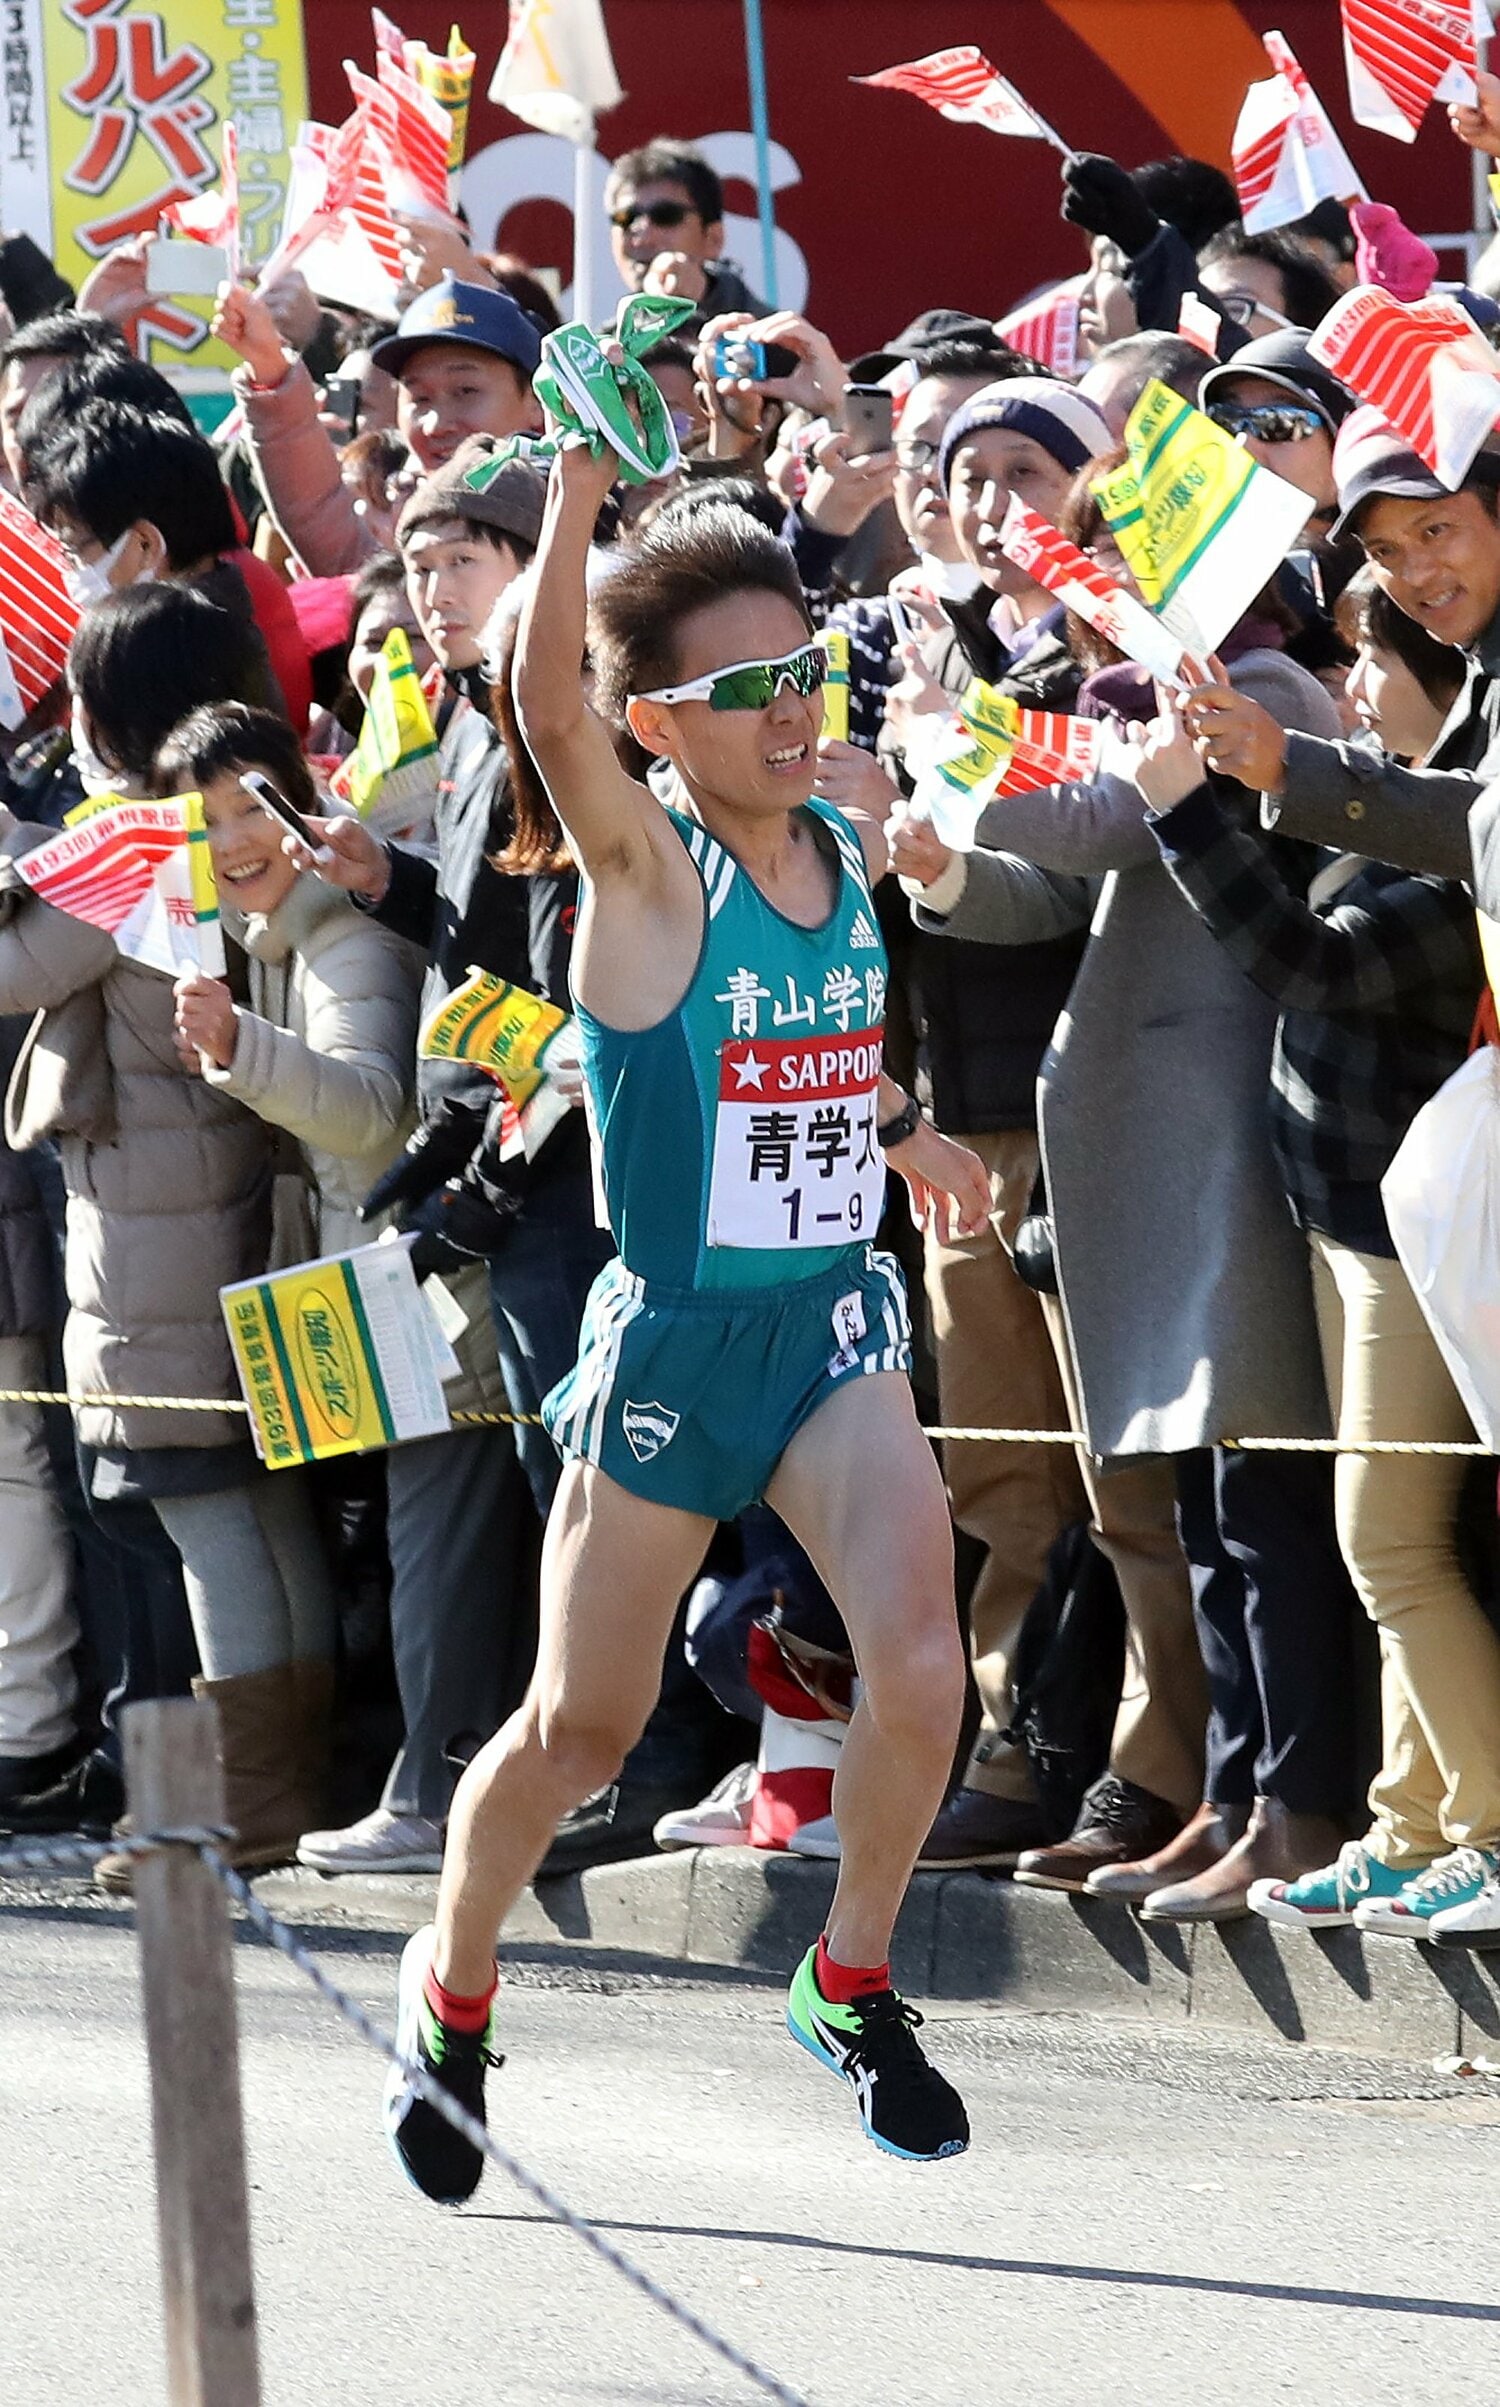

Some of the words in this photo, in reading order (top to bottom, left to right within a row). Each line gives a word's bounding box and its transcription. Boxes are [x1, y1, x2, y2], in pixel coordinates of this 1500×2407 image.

[715, 963, 886, 1038] 青山学院
[746, 1104, 877, 1182] 青学大
